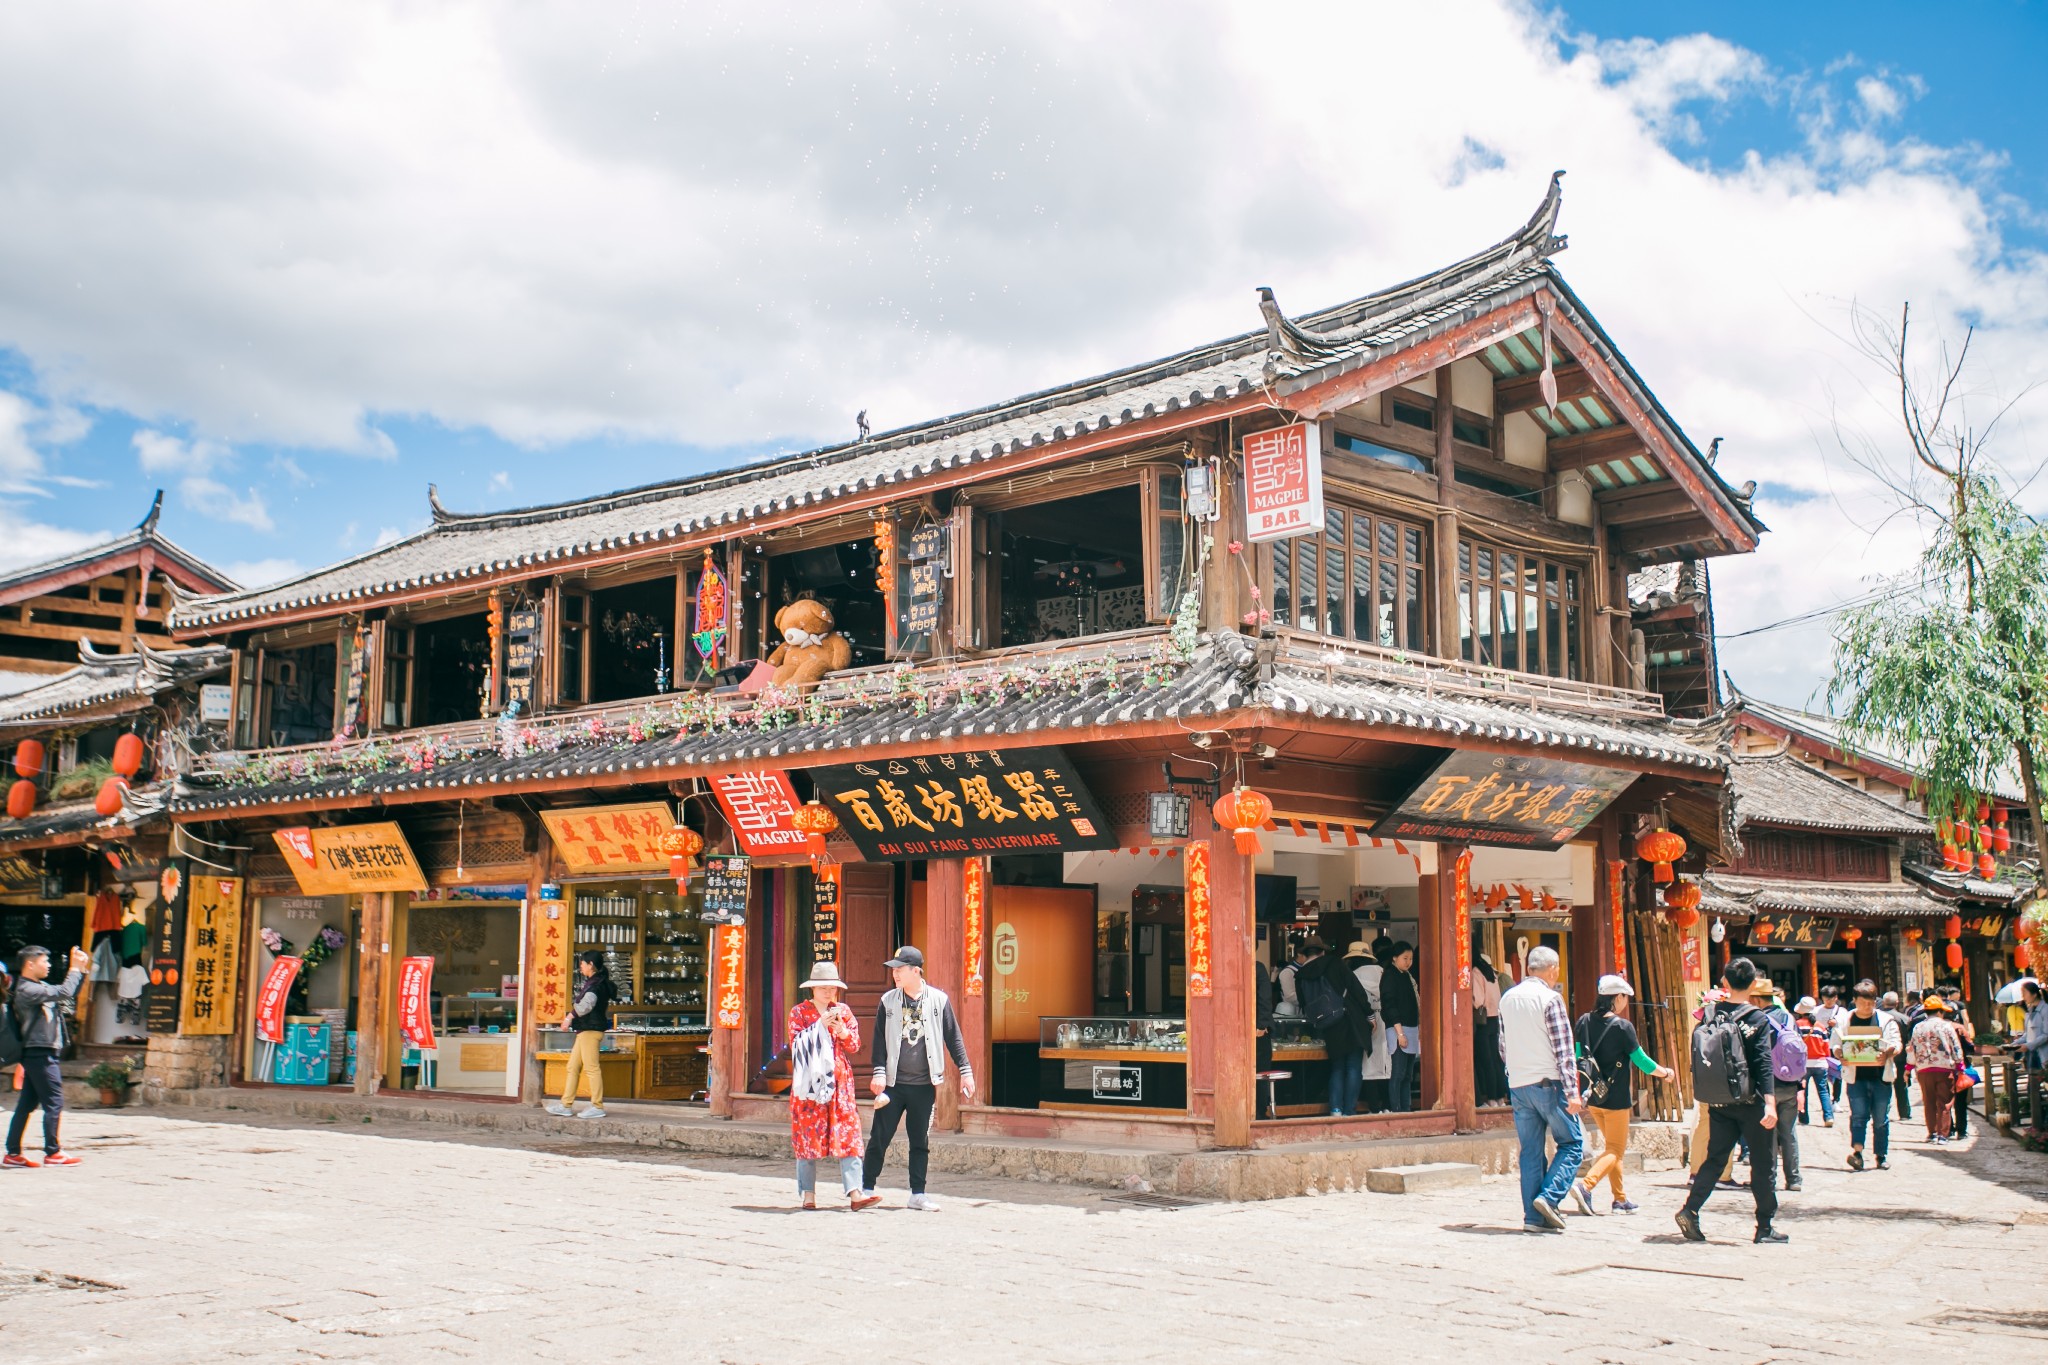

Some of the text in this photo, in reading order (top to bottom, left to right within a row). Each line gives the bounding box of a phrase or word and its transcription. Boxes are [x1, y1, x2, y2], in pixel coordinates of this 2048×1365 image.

[1254, 488, 1304, 509] MAGPIE
[1262, 509, 1301, 529] BAR
[746, 830, 807, 846] MAGPIE
[878, 833, 1061, 855] BAI SUI FANG SILVERWARE
[1396, 822, 1417, 834] BAI
[1418, 824, 1441, 836] SUI
[1443, 826, 1470, 839] FANG
[1471, 828, 1537, 845] SILVERWARE
[726, 870, 743, 878] CAFE
[1757, 913, 1812, 942] 玲珑
[543, 916, 560, 1015] 九九纯银坊
[992, 987, 1030, 1004] 岁坊
